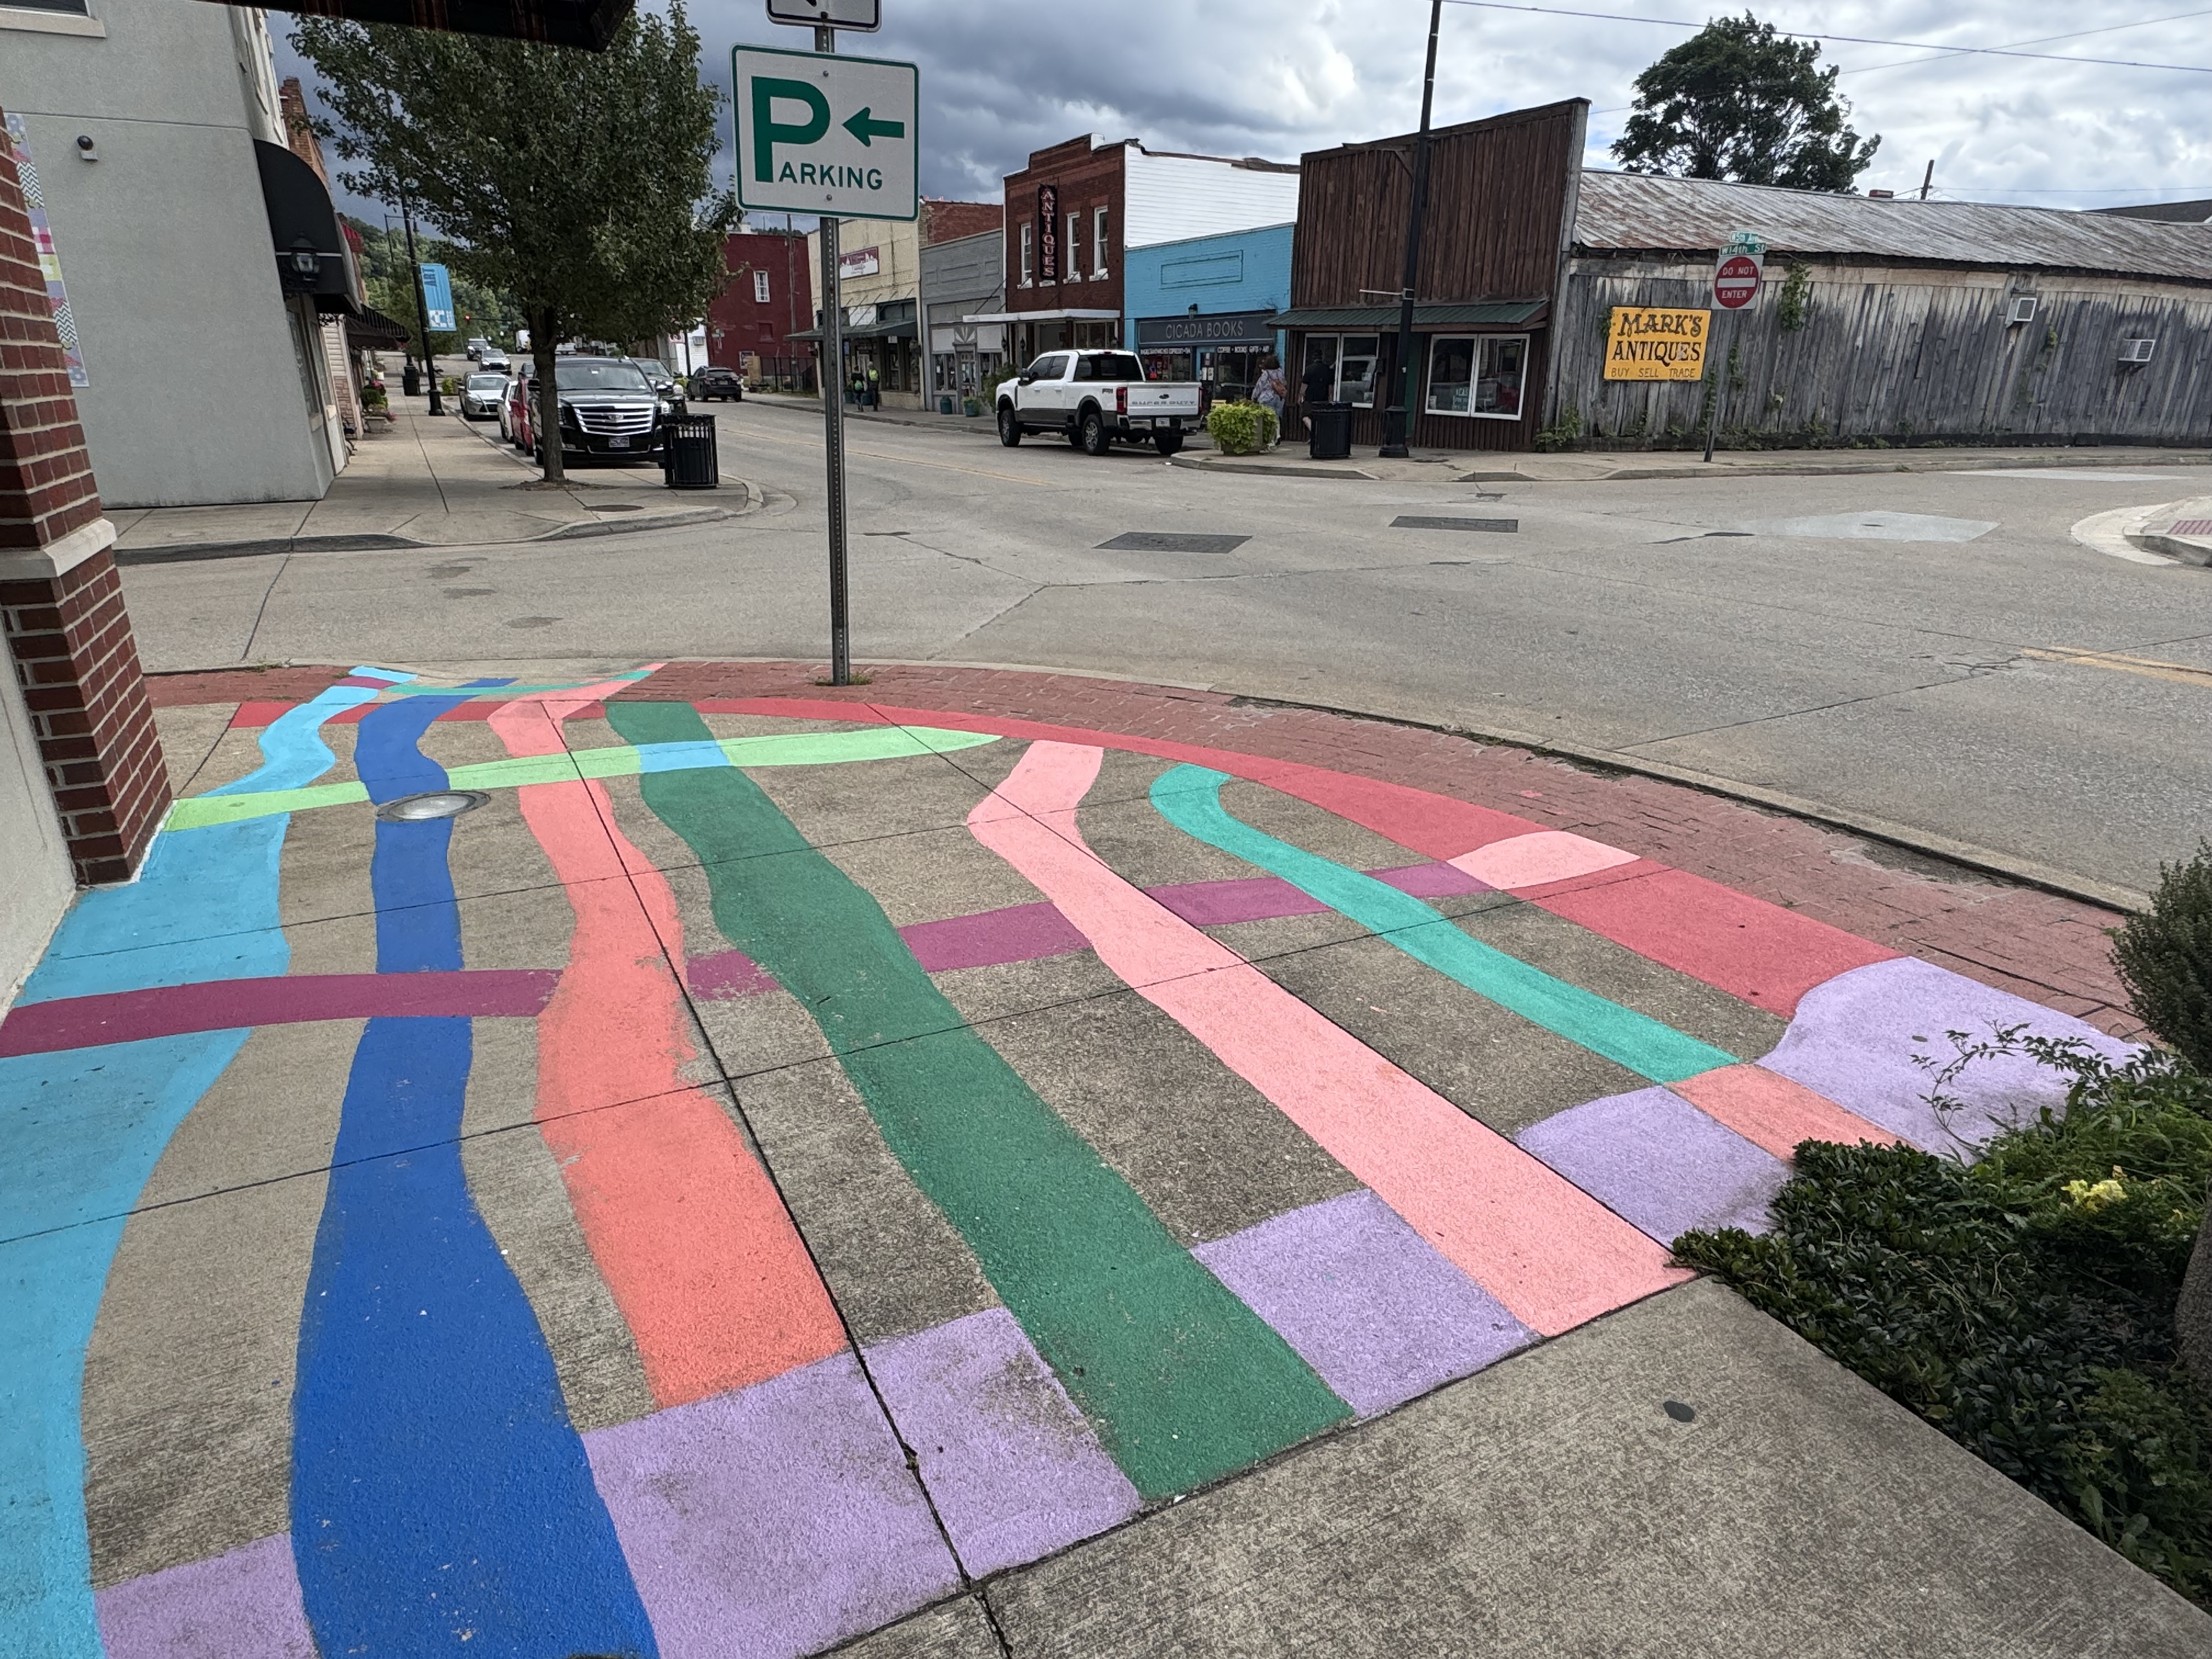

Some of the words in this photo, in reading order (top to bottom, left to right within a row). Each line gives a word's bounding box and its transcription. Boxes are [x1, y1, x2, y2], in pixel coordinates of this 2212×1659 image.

[1041, 189, 1056, 276] ANTIQUES
[1754, 243, 1765, 252] St
[421, 267, 437, 287] ART
[1723, 267, 1734, 275] DO
[1738, 266, 1754, 275] NOT
[1722, 290, 1748, 299] ENTER
[1165, 323, 1203, 338] CICADA
[1207, 321, 1243, 337] BOOKS
[1617, 313, 1703, 338] MARK'S
[1611, 340, 1702, 367] ANTIQUES
[1611, 368, 1630, 377] BUY
[1638, 368, 1659, 377] SELL
[1669, 368, 1696, 378] TRADE
